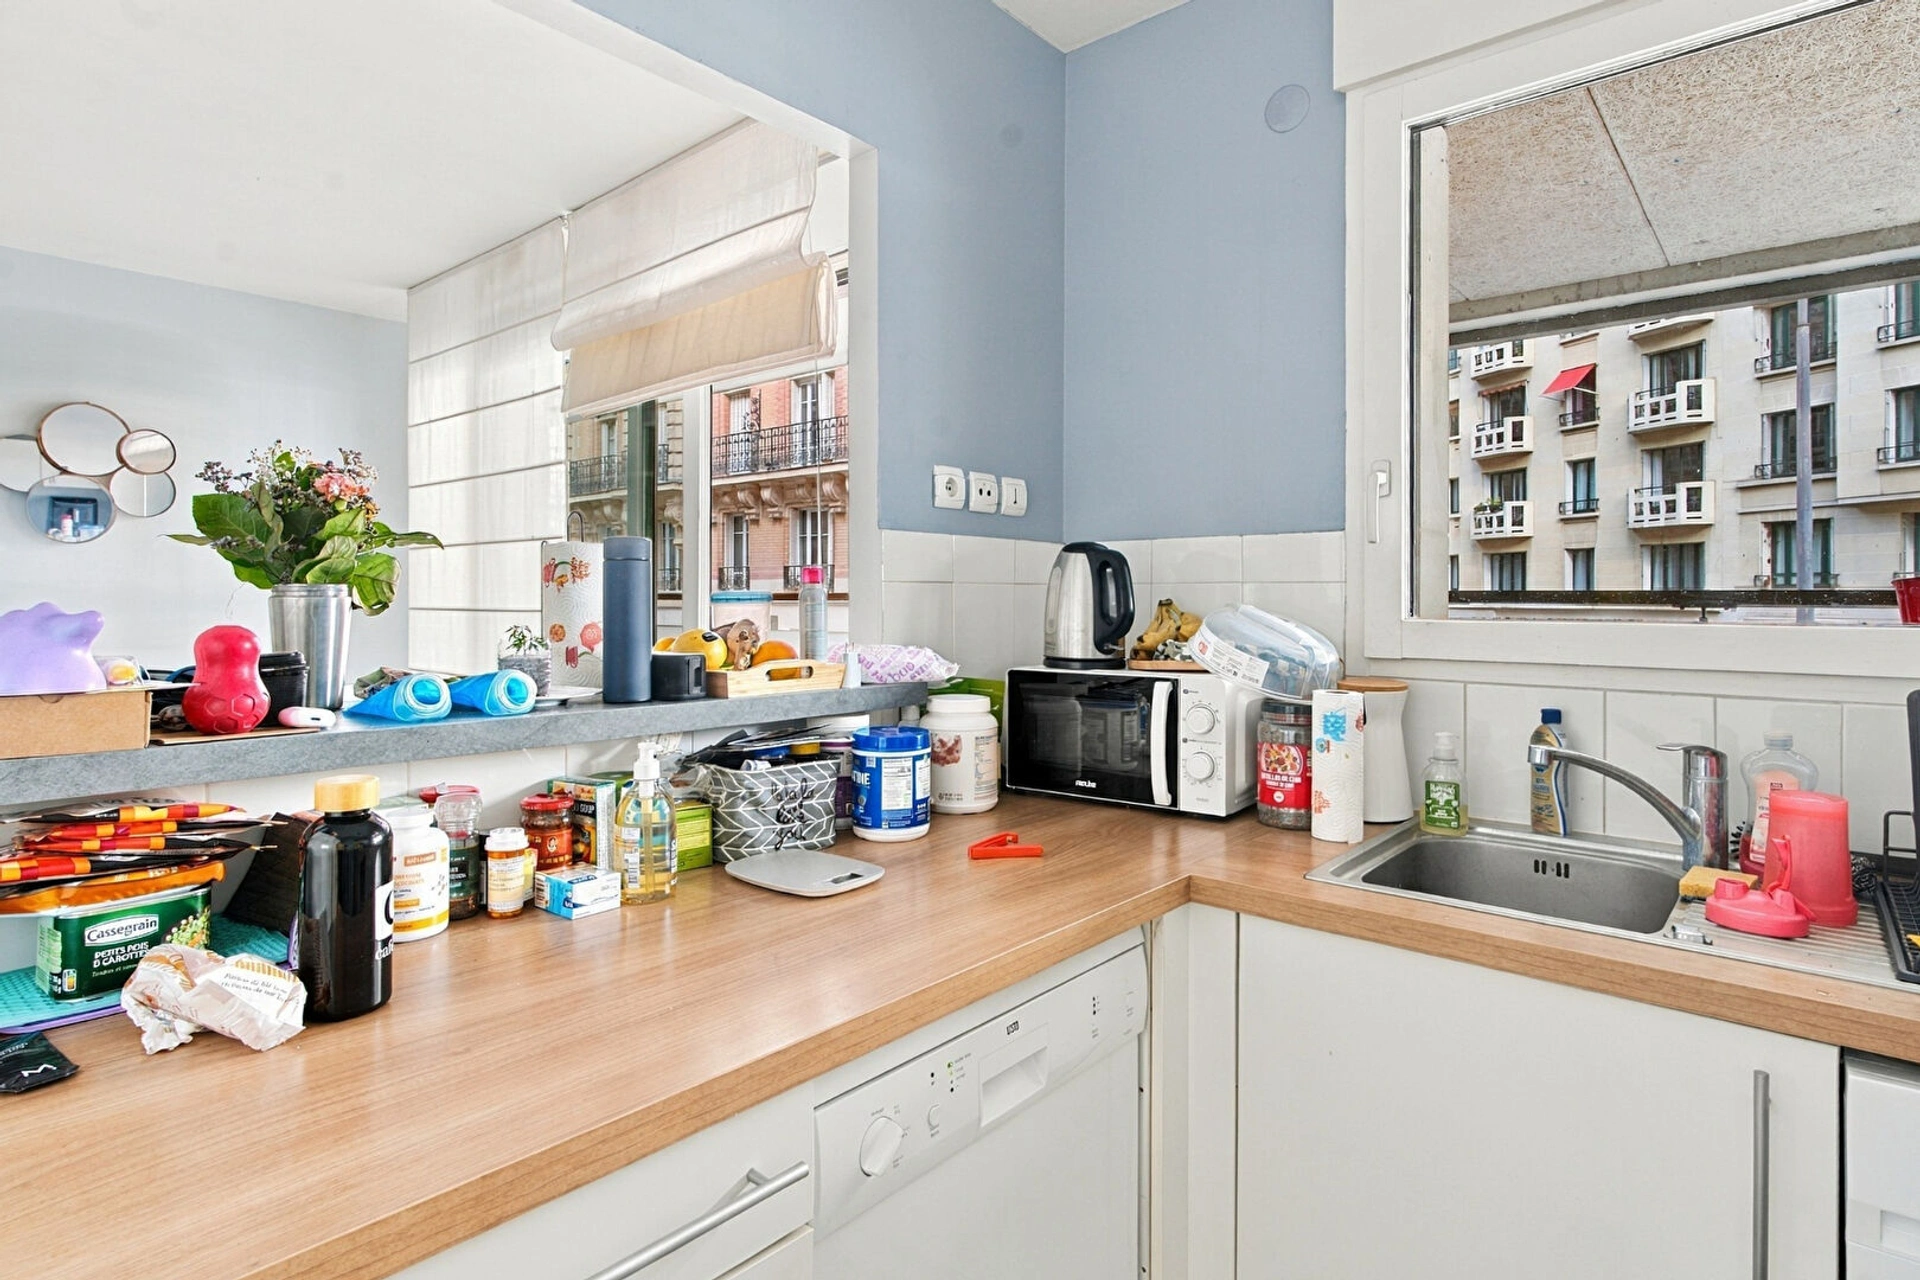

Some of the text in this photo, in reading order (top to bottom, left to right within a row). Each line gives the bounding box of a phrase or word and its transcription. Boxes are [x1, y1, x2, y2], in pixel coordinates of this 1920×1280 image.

[87, 918, 158, 942] Cassegrain
[95, 941, 149, 959] PETITS POIS
